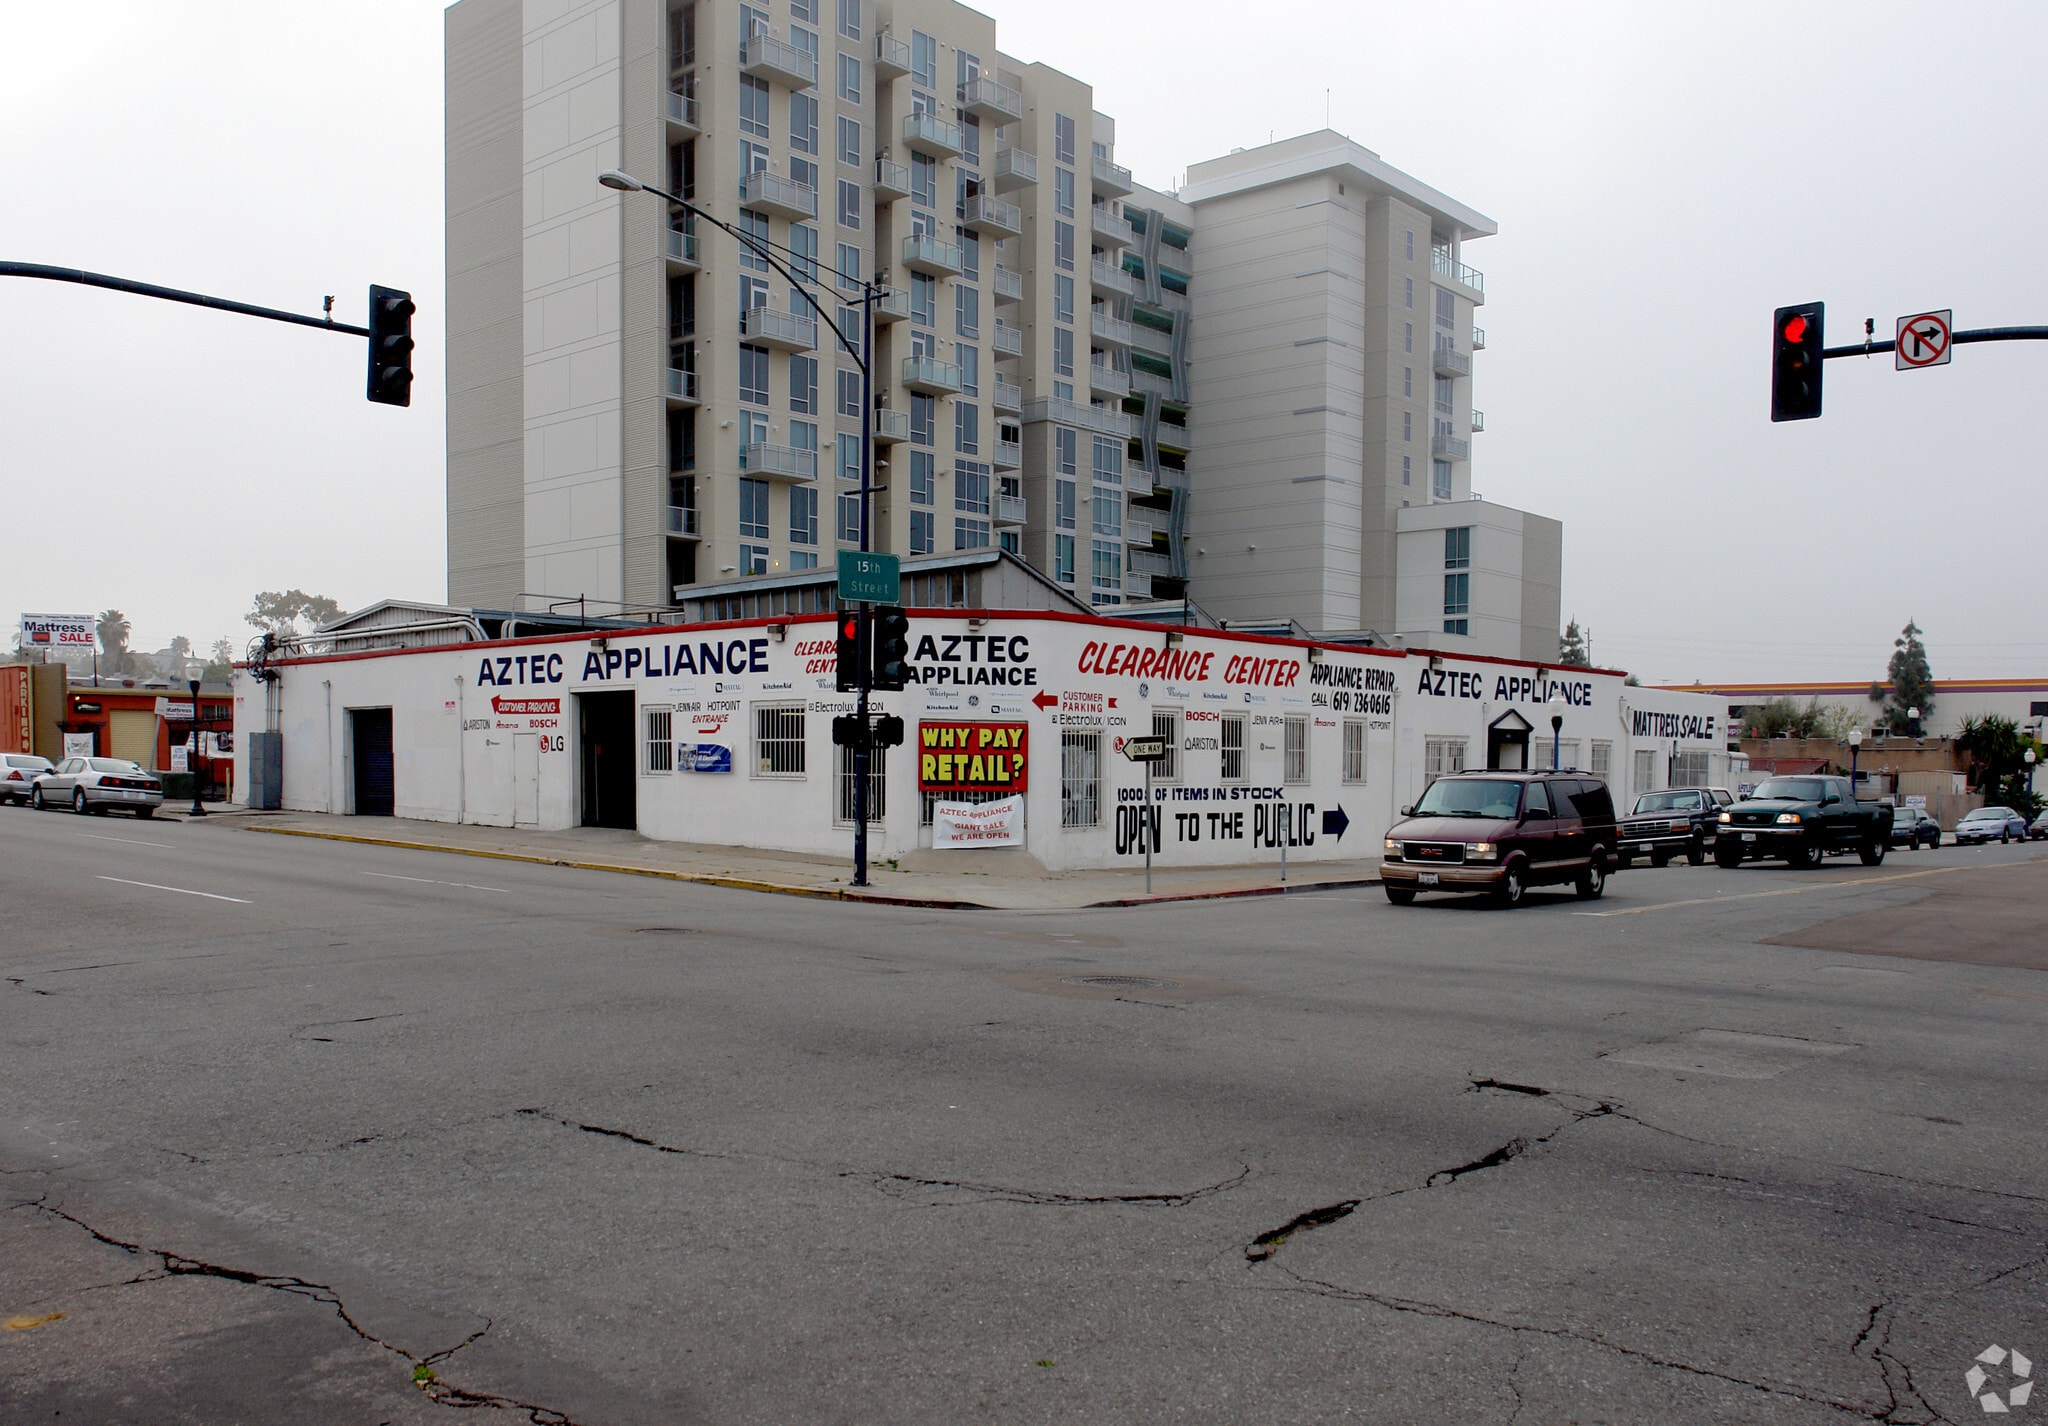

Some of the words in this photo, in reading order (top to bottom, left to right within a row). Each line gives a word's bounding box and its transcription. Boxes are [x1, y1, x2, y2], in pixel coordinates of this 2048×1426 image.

[857, 561, 881, 574] 15th
[851, 581, 888, 594] Street
[25, 621, 86, 633] Mattress
[60, 632, 94, 643] SALE
[794, 640, 838, 657] CLEARA
[914, 635, 1029, 663] AZTEC
[478, 653, 563, 686] AZTEC
[582, 639, 769, 681] APPLIANCE
[805, 658, 838, 674] CENT
[1078, 641, 1215, 681] CLEARANCE
[1224, 655, 1300, 687] CENTER
[904, 665, 1037, 686] APPLIANCE
[1310, 664, 1362, 689] APPLIANCE
[1365, 668, 1395, 692] REPAIR
[762, 682, 791, 690] KitchenAid
[1418, 669, 1482, 699] AZTEC
[1494, 676, 1591, 706] APPLIANCE
[929, 690, 959, 698] Whirlpool
[1063, 691, 1103, 701] CUSTOMER
[1203, 692, 1227, 700] KitchenAid
[20, 671, 29, 737] PARKING
[498, 702, 526, 712] CUSTOMER
[527, 701, 556, 712] PARKING
[707, 700, 740, 711] HOTPOINT
[815, 701, 855, 712] Electrolux
[1063, 702, 1103, 712] PARKING
[1312, 693, 1327, 704] CALL
[1330, 690, 1351, 711] (619)
[1354, 693, 1391, 714] 236-0616
[692, 714, 729, 723] ENTRANCE
[1107, 717, 1126, 726] ICON
[1186, 711, 1219, 721] BOSCH
[1252, 716, 1267, 725] JENN
[469, 719, 490, 730] ARISTON
[496, 720, 518, 729] Amana
[529, 719, 557, 728] BOSCH
[1633, 710, 1679, 738] MATTRESS
[1680, 715, 1714, 739] SALE
[550, 735, 564, 751] LG
[922, 728, 970, 747] WHY
[979, 728, 1023, 748] PAY
[1192, 737, 1218, 750] ARISTON
[1134, 744, 1146, 754] ONE
[1148, 743, 1161, 753] WAY
[922, 753, 1024, 781] RETAIL?
[1155, 788, 1167, 800] OF
[1172, 788, 1209, 800] ITEMS
[1212, 788, 1226, 800] IN
[1230, 787, 1284, 800] STOCK
[940, 808, 967, 816] AZTEC
[969, 805, 1013, 819] APPLIANCE
[955, 823, 981, 831] GIANT
[984, 820, 1005, 831] SALE
[1116, 804, 1161, 855] OPEN
[1175, 813, 1199, 842] TO
[1207, 812, 1243, 840] THE
